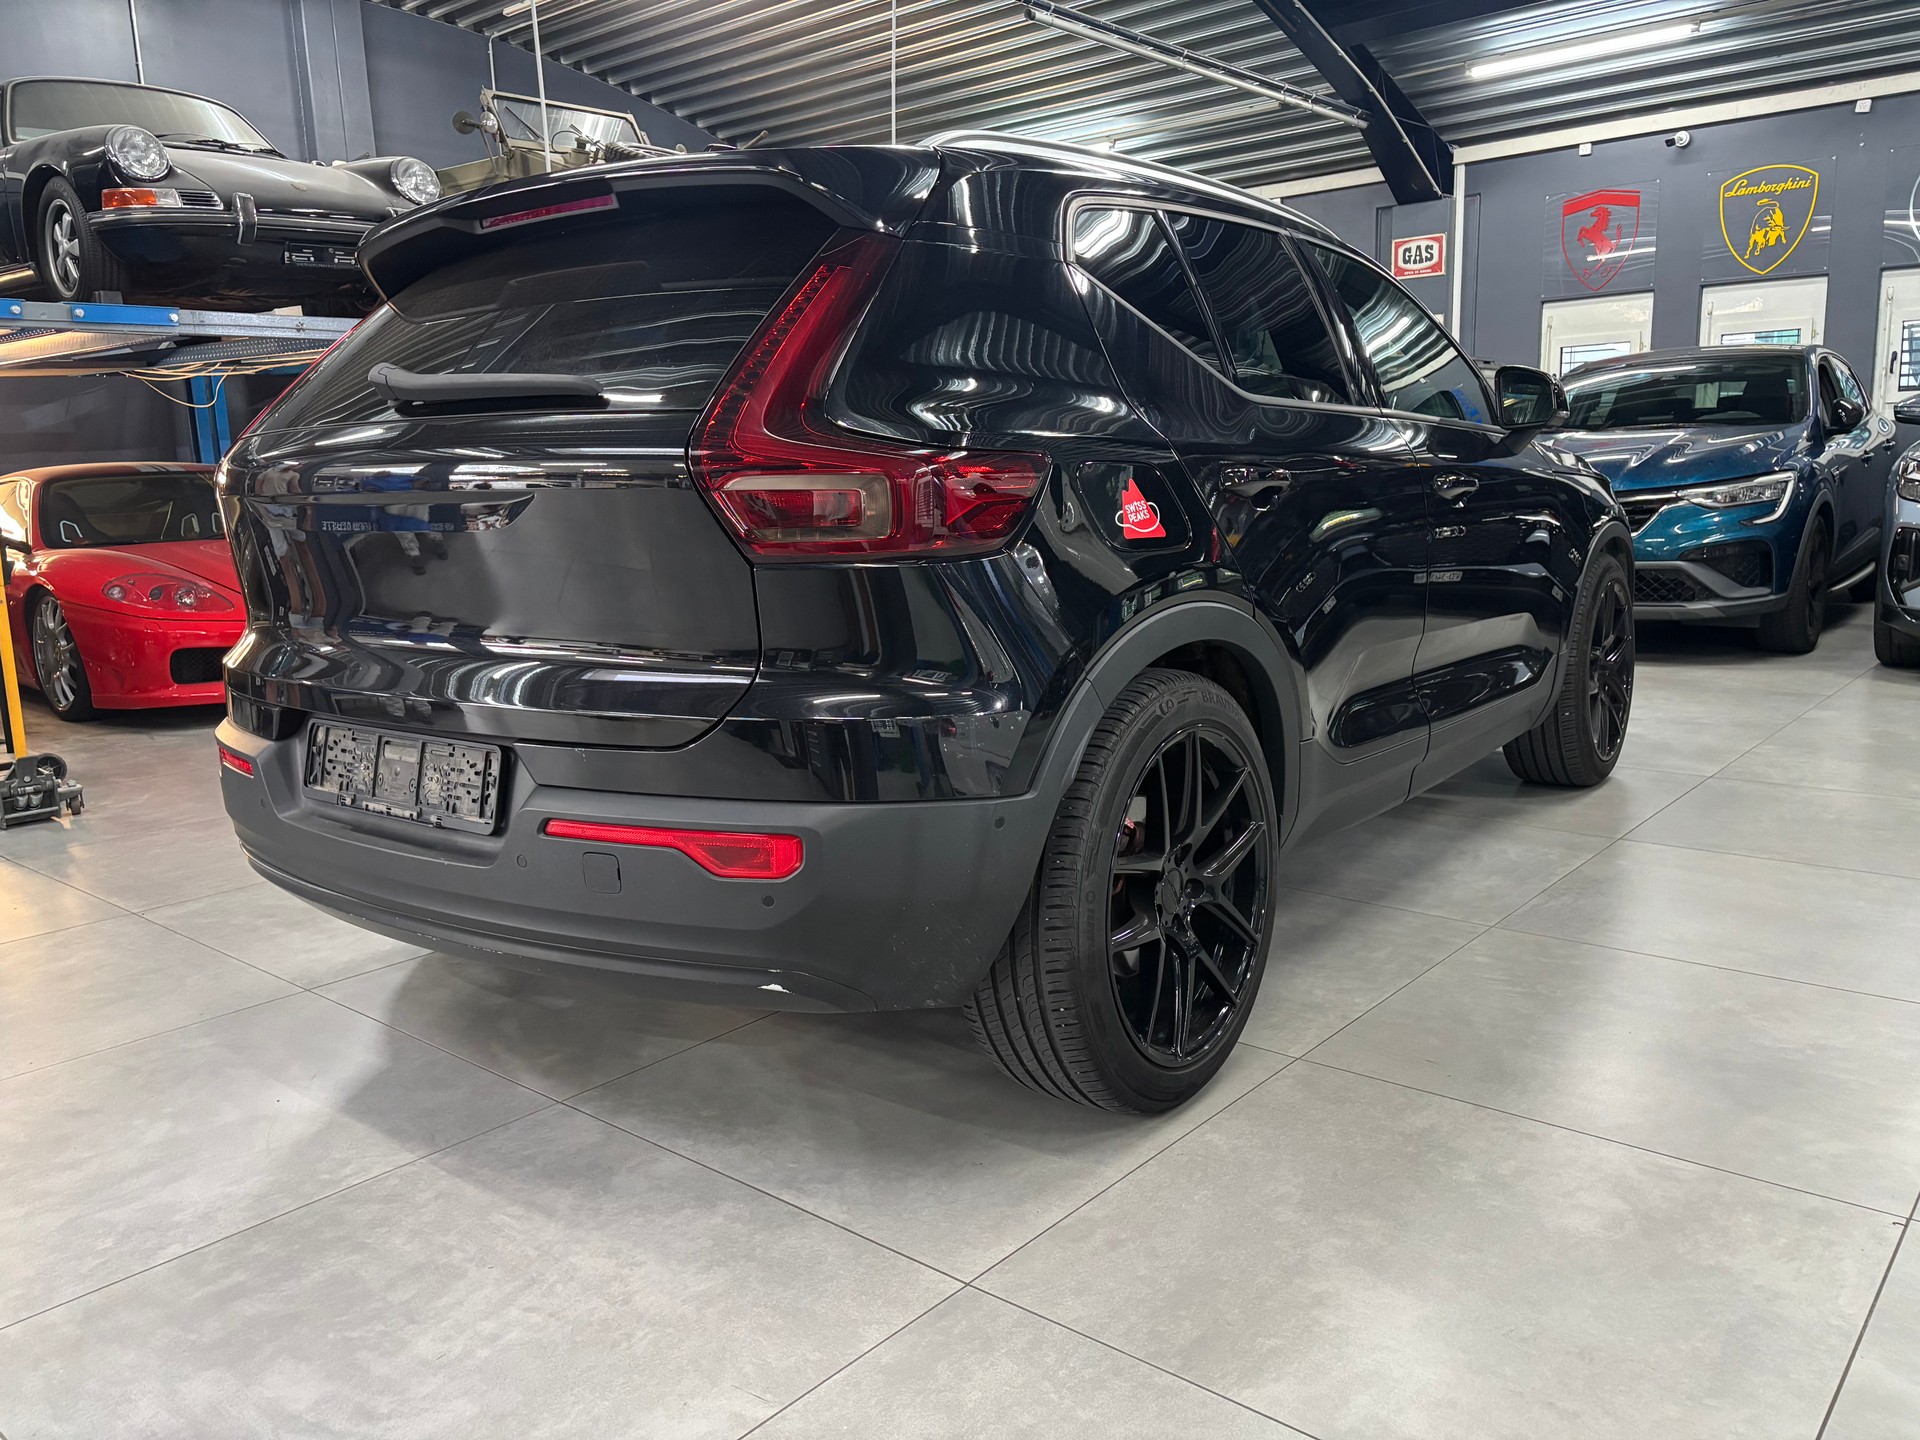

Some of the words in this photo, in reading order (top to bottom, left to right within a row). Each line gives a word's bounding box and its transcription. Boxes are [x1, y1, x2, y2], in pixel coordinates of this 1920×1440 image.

[1724, 175, 1813, 199] Lamborghini
[1403, 244, 1434, 265] GAS
[1124, 500, 1147, 514] SWISS
[1127, 509, 1150, 524] PEAKS
